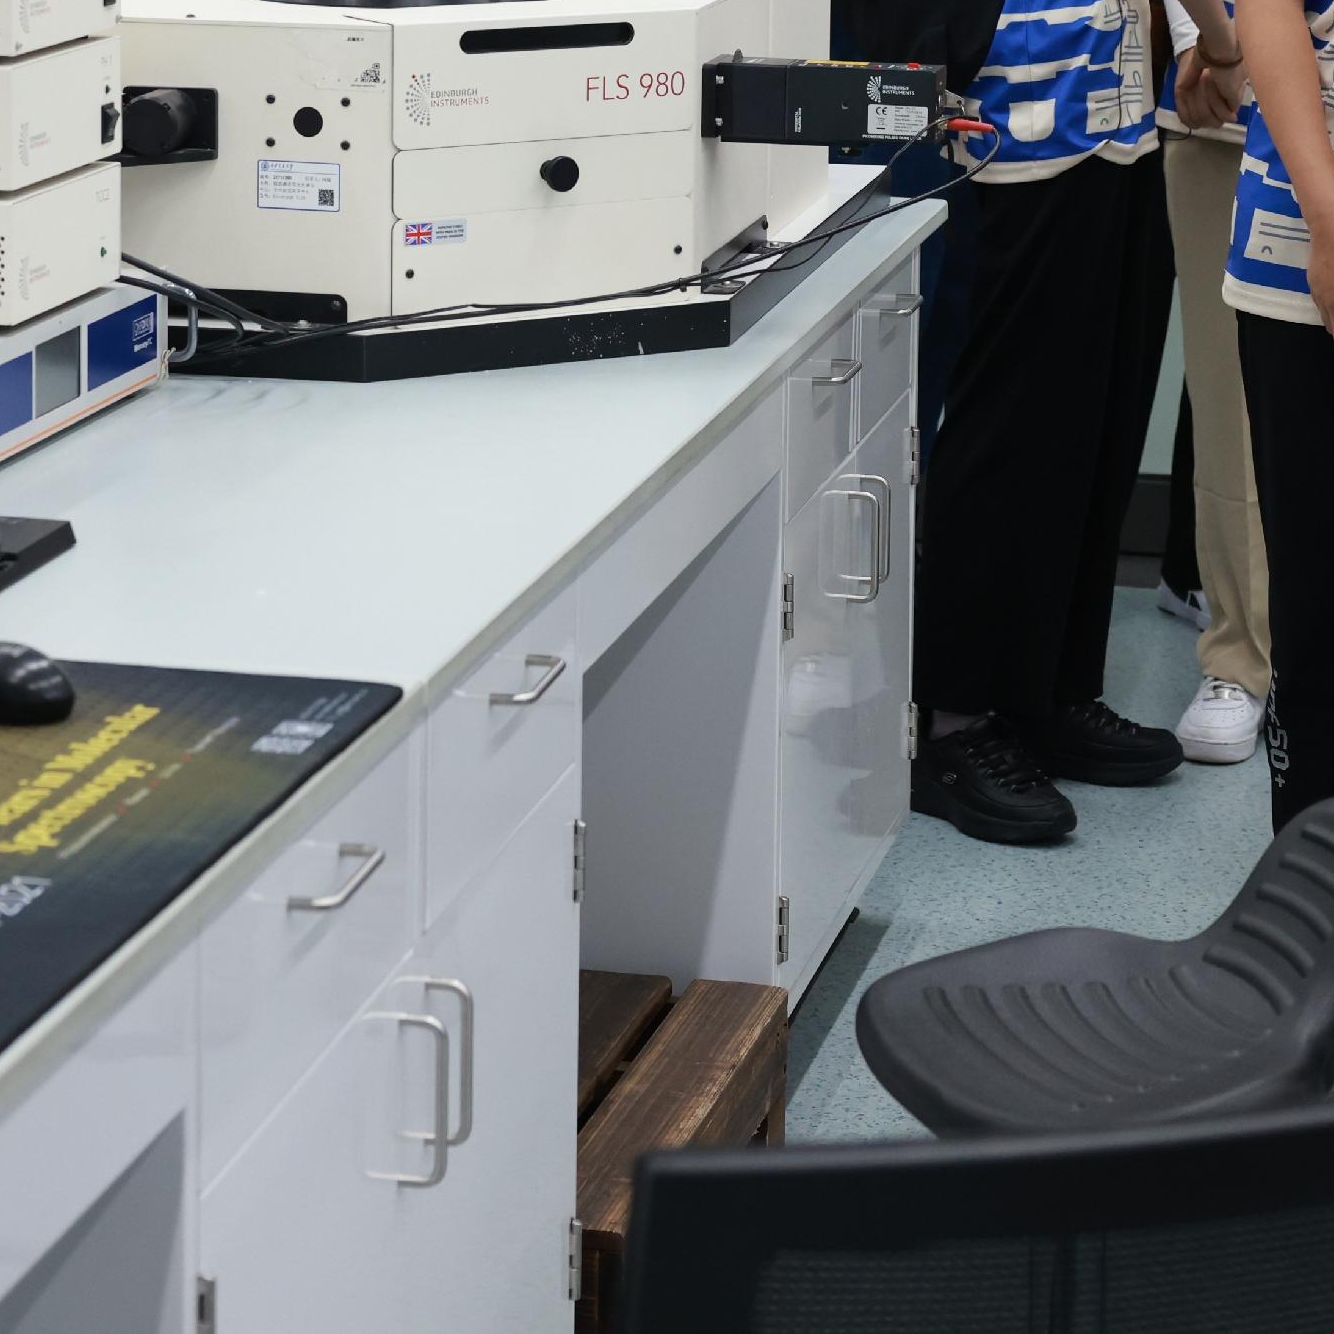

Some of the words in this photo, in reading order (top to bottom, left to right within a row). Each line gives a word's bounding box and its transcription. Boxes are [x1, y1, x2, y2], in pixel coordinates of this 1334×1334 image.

[586, 73, 630, 101] FLS
[639, 70, 685, 99] 980
[430, 88, 478, 98] EDINBURGH
[430, 96, 490, 107] INSTRUMENTS
